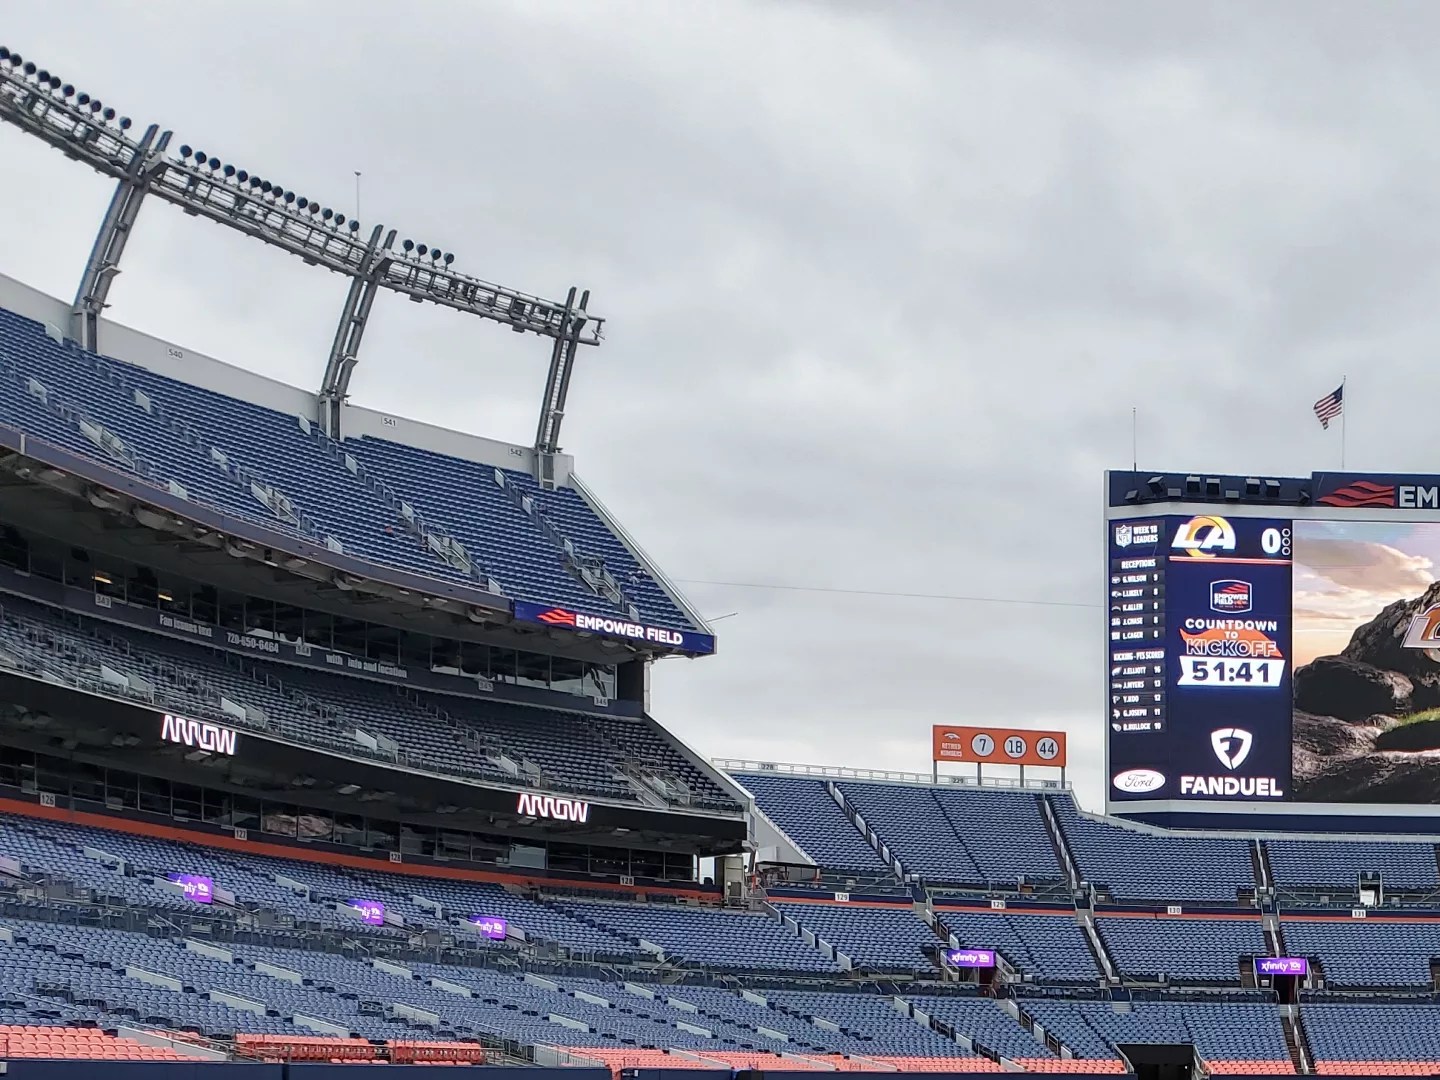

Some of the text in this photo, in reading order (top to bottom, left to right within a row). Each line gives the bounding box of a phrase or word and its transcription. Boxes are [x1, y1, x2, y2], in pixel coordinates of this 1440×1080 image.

[169, 348, 183, 359] 540
[383, 417, 397, 427] 541
[510, 448, 522, 457] 542
[1133, 526, 1149, 535] WEEK
[1133, 534, 1158, 544] LEADERS
[1261, 527, 1281, 554] 0
[1121, 559, 1156, 570] RECEPTIONS
[160, 614, 173, 628] Fan
[1185, 619, 1277, 631] COUNTDOWN
[575, 614, 684, 646] EMPOWER FIELD
[1224, 631, 1239, 639] TO
[1186, 639, 1277, 657] KICKOFF
[326, 654, 343, 666] with
[363, 660, 377, 672] and
[378, 663, 407, 678] location
[1192, 660, 1269, 683] 51:41
[161, 714, 236, 755] ARROW
[980, 739, 986, 752] 7
[1009, 740, 1023, 754] 18
[1040, 742, 1055, 755] 44
[1124, 774, 1154, 790] Ford
[1180, 776, 1283, 797] FANDUEL
[517, 794, 588, 823] ARROW
[952, 953, 977, 963] xfinity
[1261, 961, 1288, 972] xfinity
